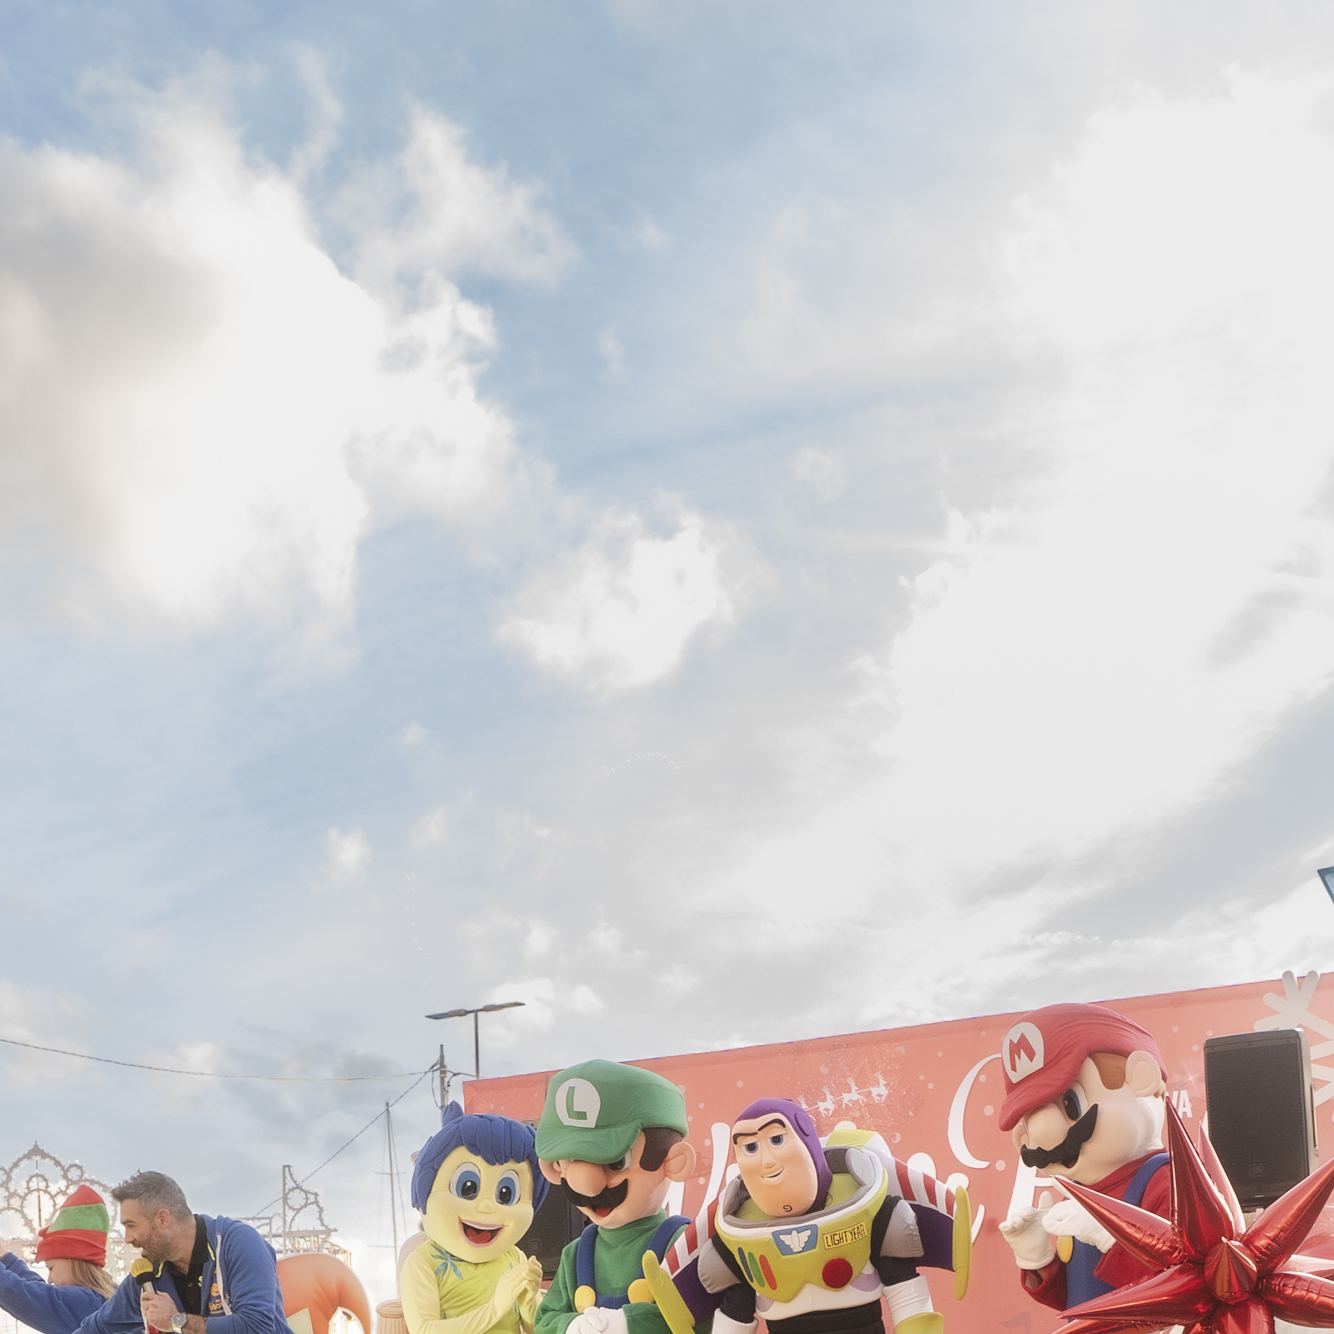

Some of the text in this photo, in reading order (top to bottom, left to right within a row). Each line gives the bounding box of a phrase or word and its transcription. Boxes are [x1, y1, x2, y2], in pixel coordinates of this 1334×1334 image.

[1009, 1032, 1036, 1074] M
[565, 1086, 588, 1121] L
[1165, 1090, 1193, 1118] VA
[825, 1223, 866, 1248] LIGHTYEAR
